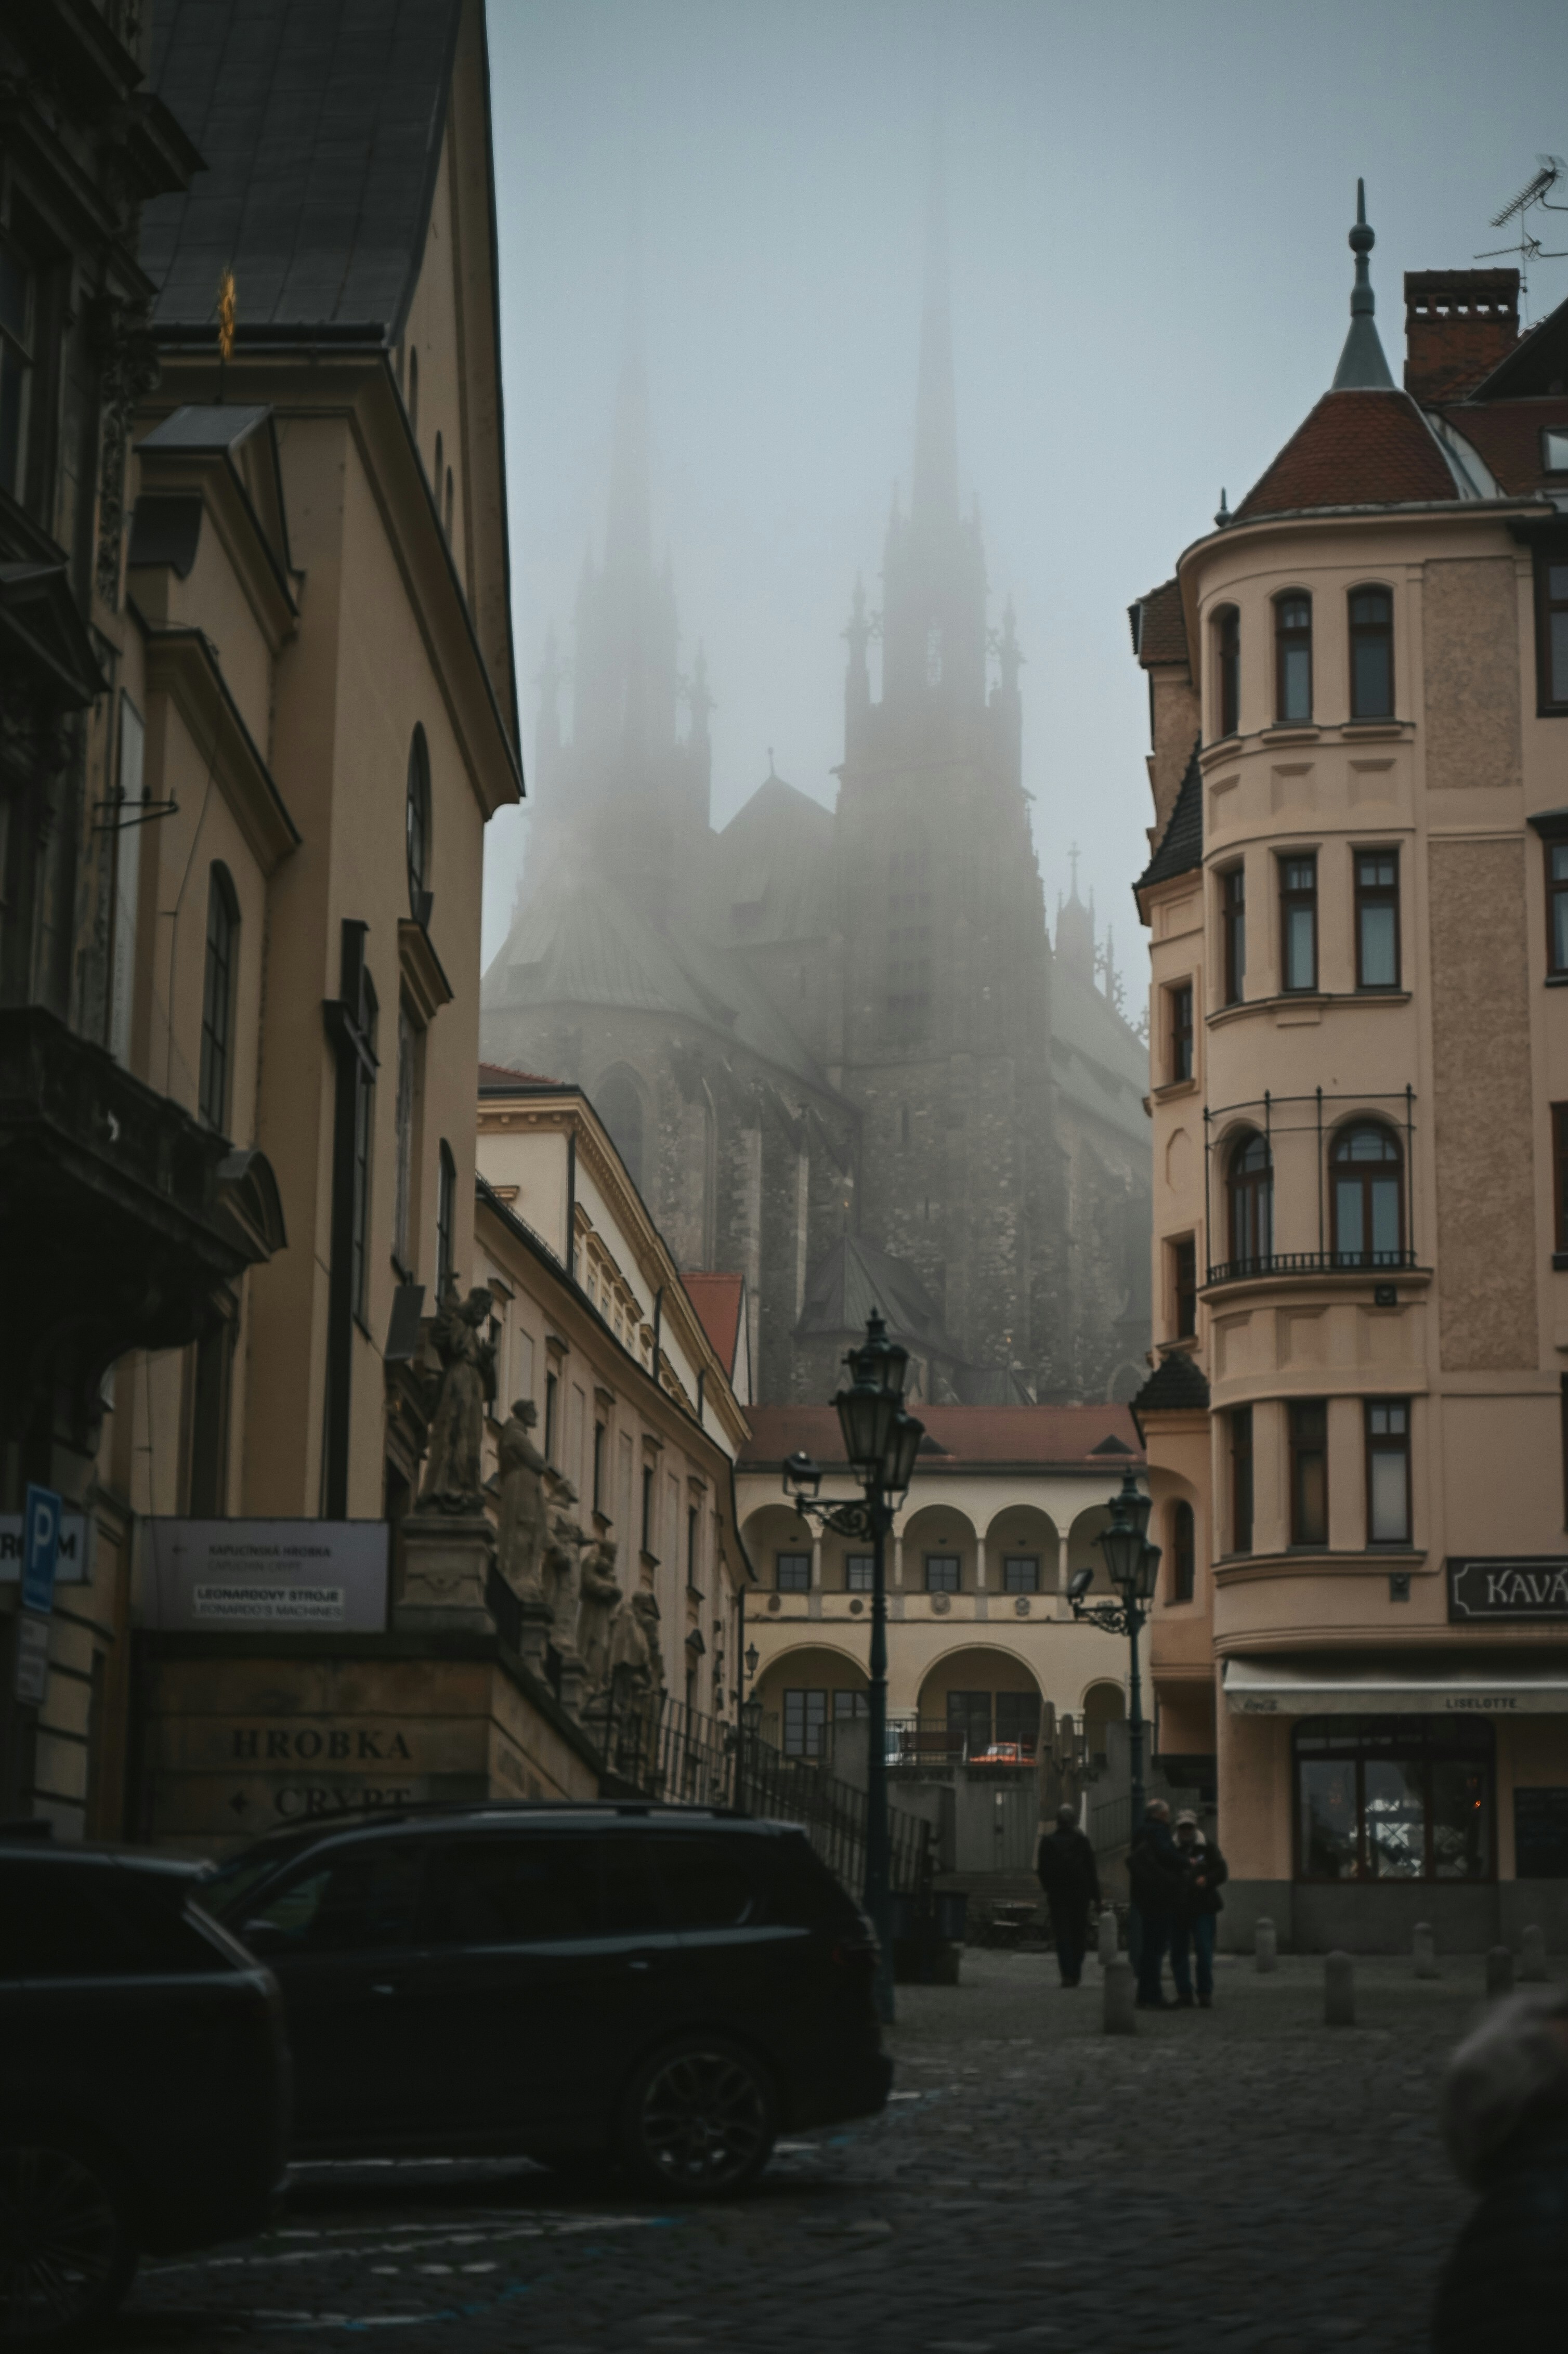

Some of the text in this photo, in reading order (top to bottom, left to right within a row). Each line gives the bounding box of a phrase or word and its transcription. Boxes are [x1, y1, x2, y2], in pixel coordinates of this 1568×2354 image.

[31, 1502, 54, 1570] P
[283, 1546, 331, 1557] HROBKA
[198, 1589, 338, 1602] LEONARDOVY STROJE
[233, 1729, 411, 1760] HROBKA
